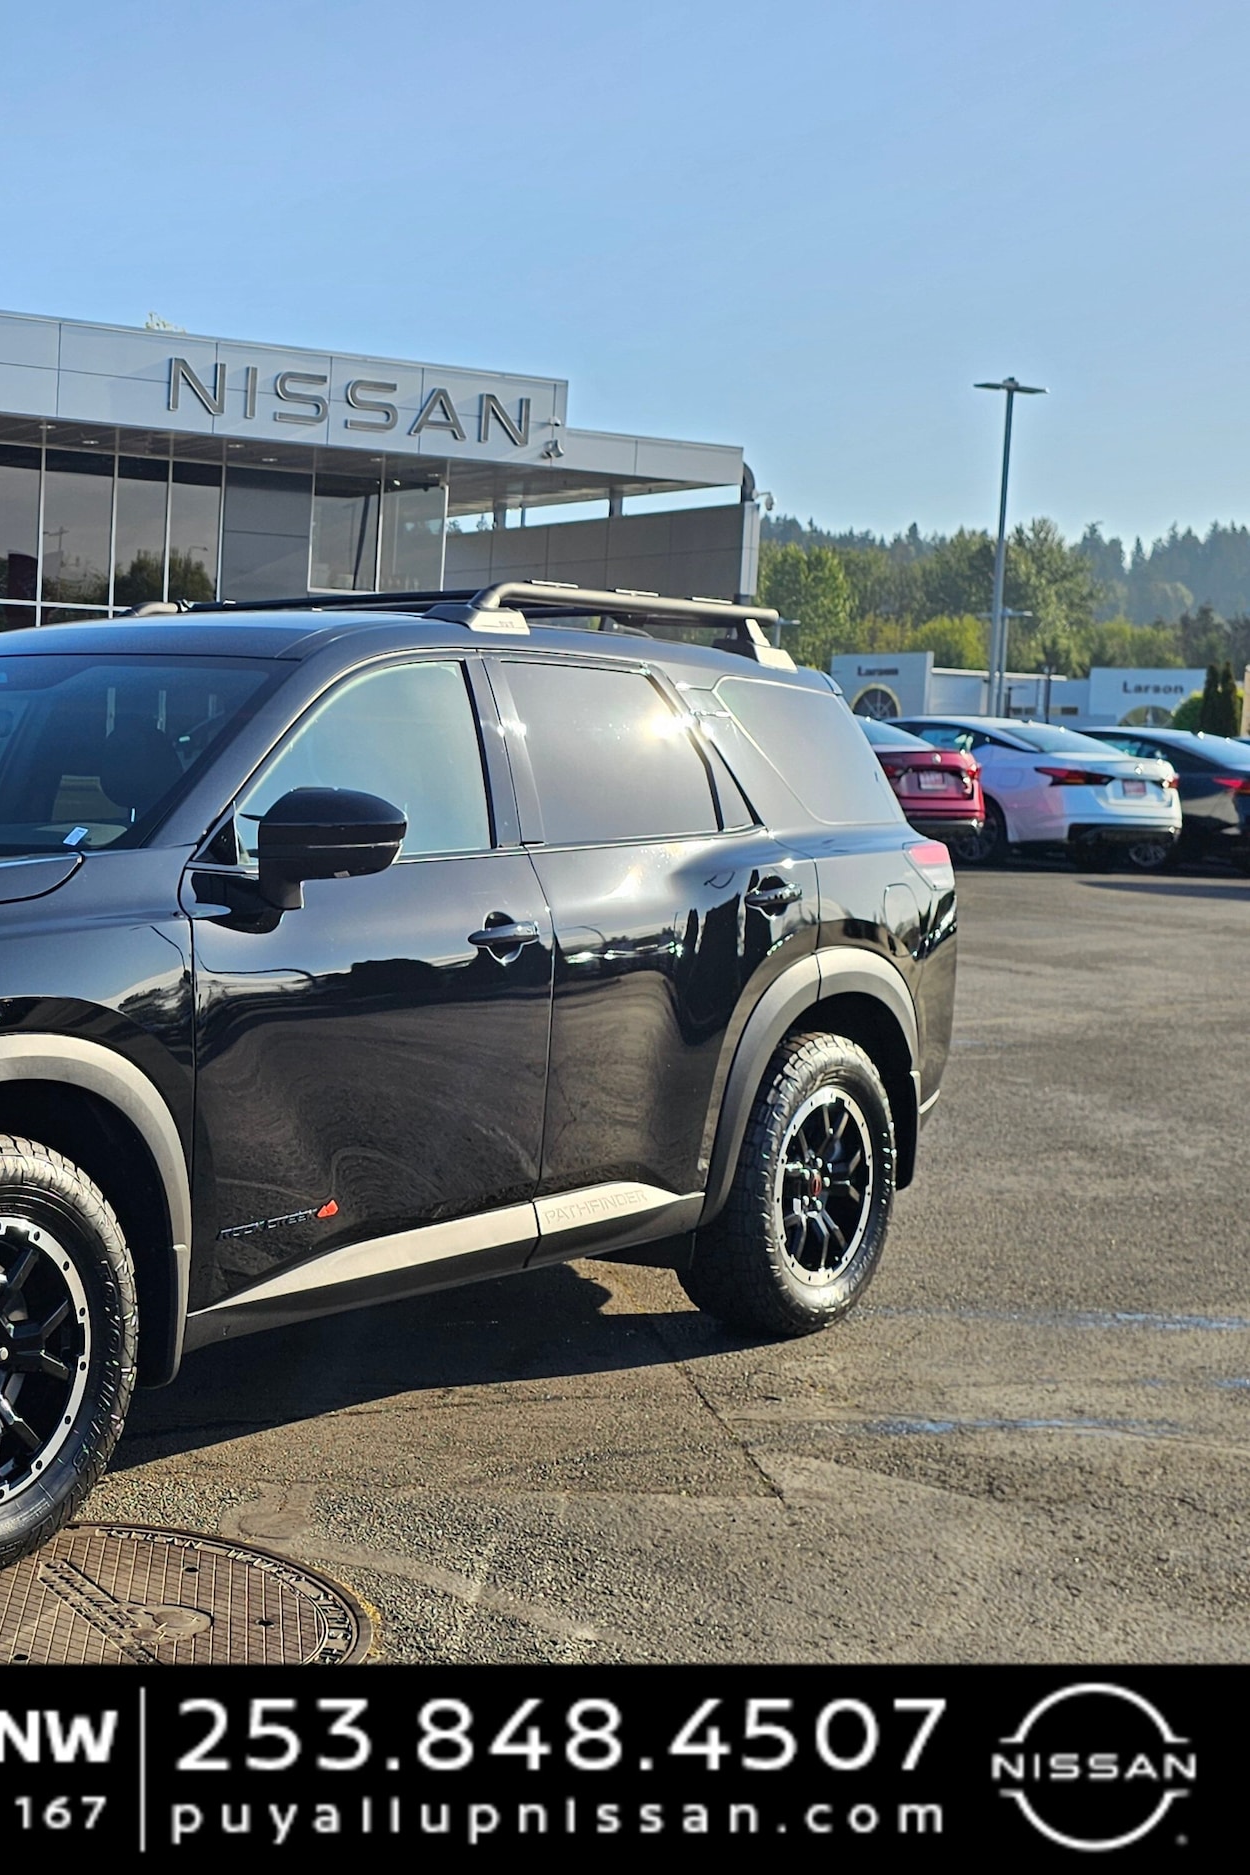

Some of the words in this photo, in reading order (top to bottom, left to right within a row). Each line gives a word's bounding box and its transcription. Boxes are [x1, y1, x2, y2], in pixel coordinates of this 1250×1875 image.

[168, 357, 532, 447] NISSAN
[856, 665, 899, 677] Larson
[1121, 680, 1184, 696] Larson
[543, 1189, 649, 1224] PATHFINDER
